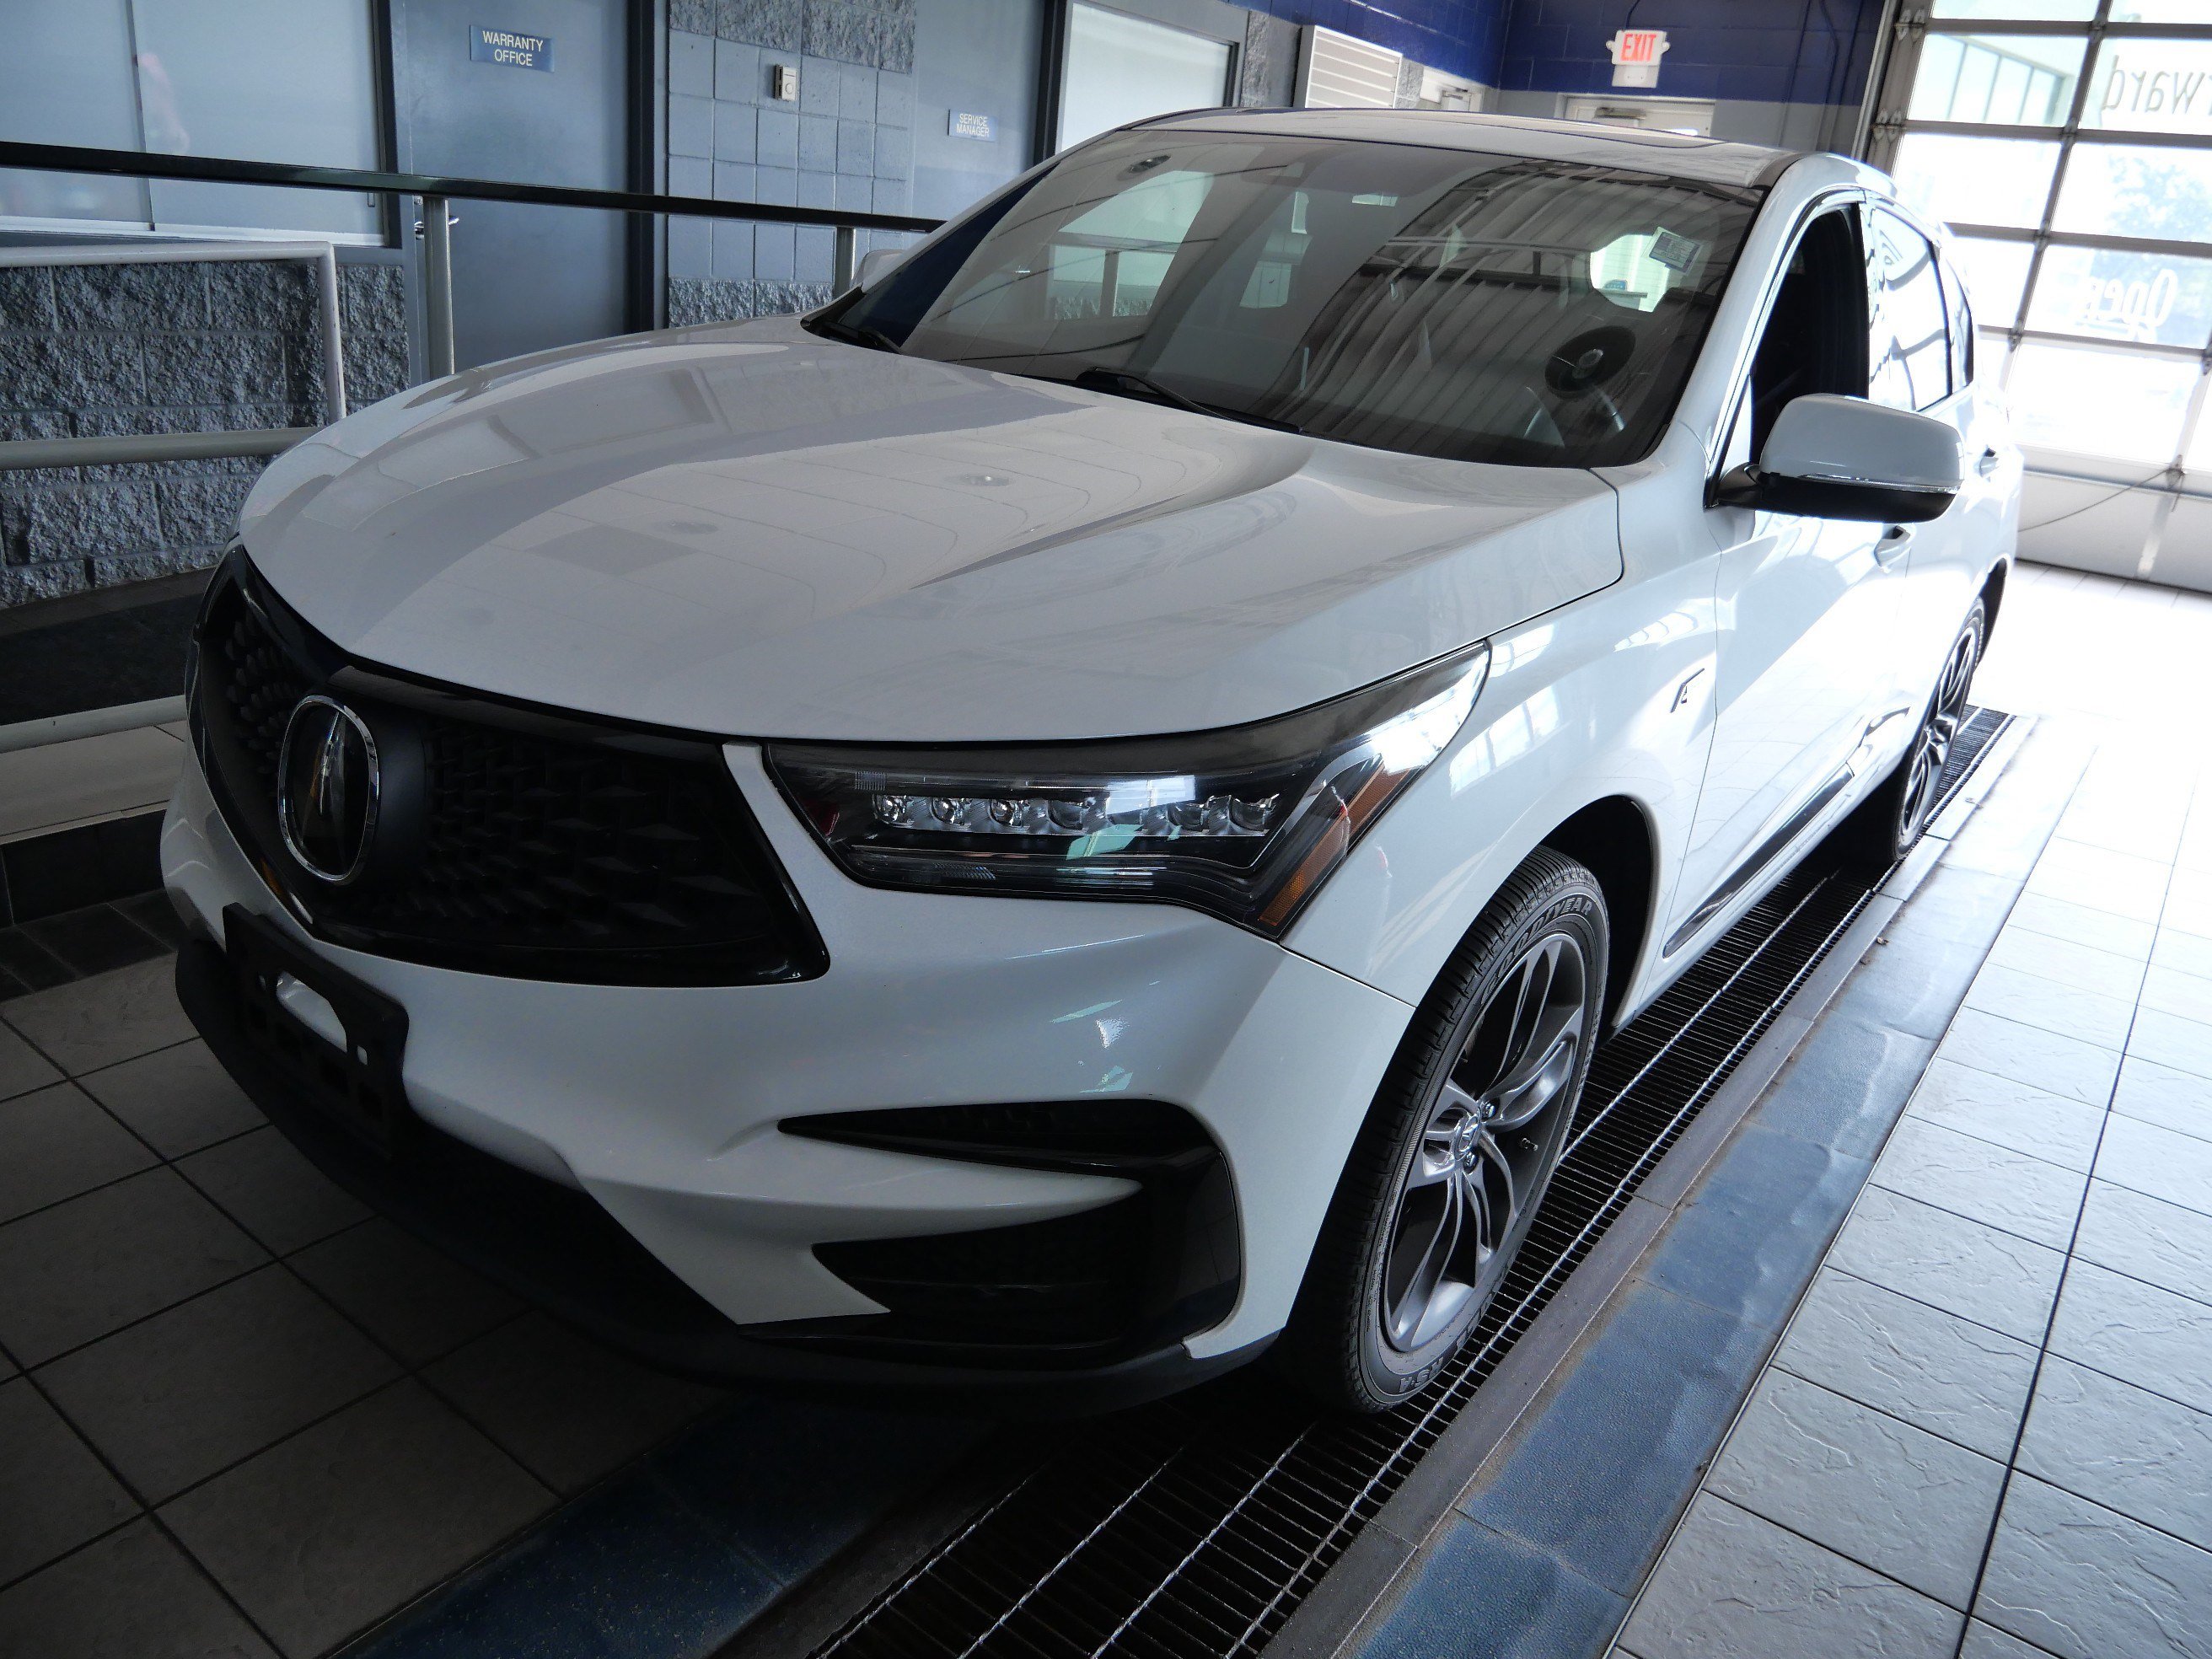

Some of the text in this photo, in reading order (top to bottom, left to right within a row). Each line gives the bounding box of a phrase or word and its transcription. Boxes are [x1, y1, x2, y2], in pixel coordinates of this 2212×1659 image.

[482, 30, 544, 52] WARRANTY
[1620, 33, 1657, 62] EXIT
[494, 48, 533, 67] OFFICE
[958, 113, 989, 127] SERVICE
[956, 123, 990, 138] MANAGER
